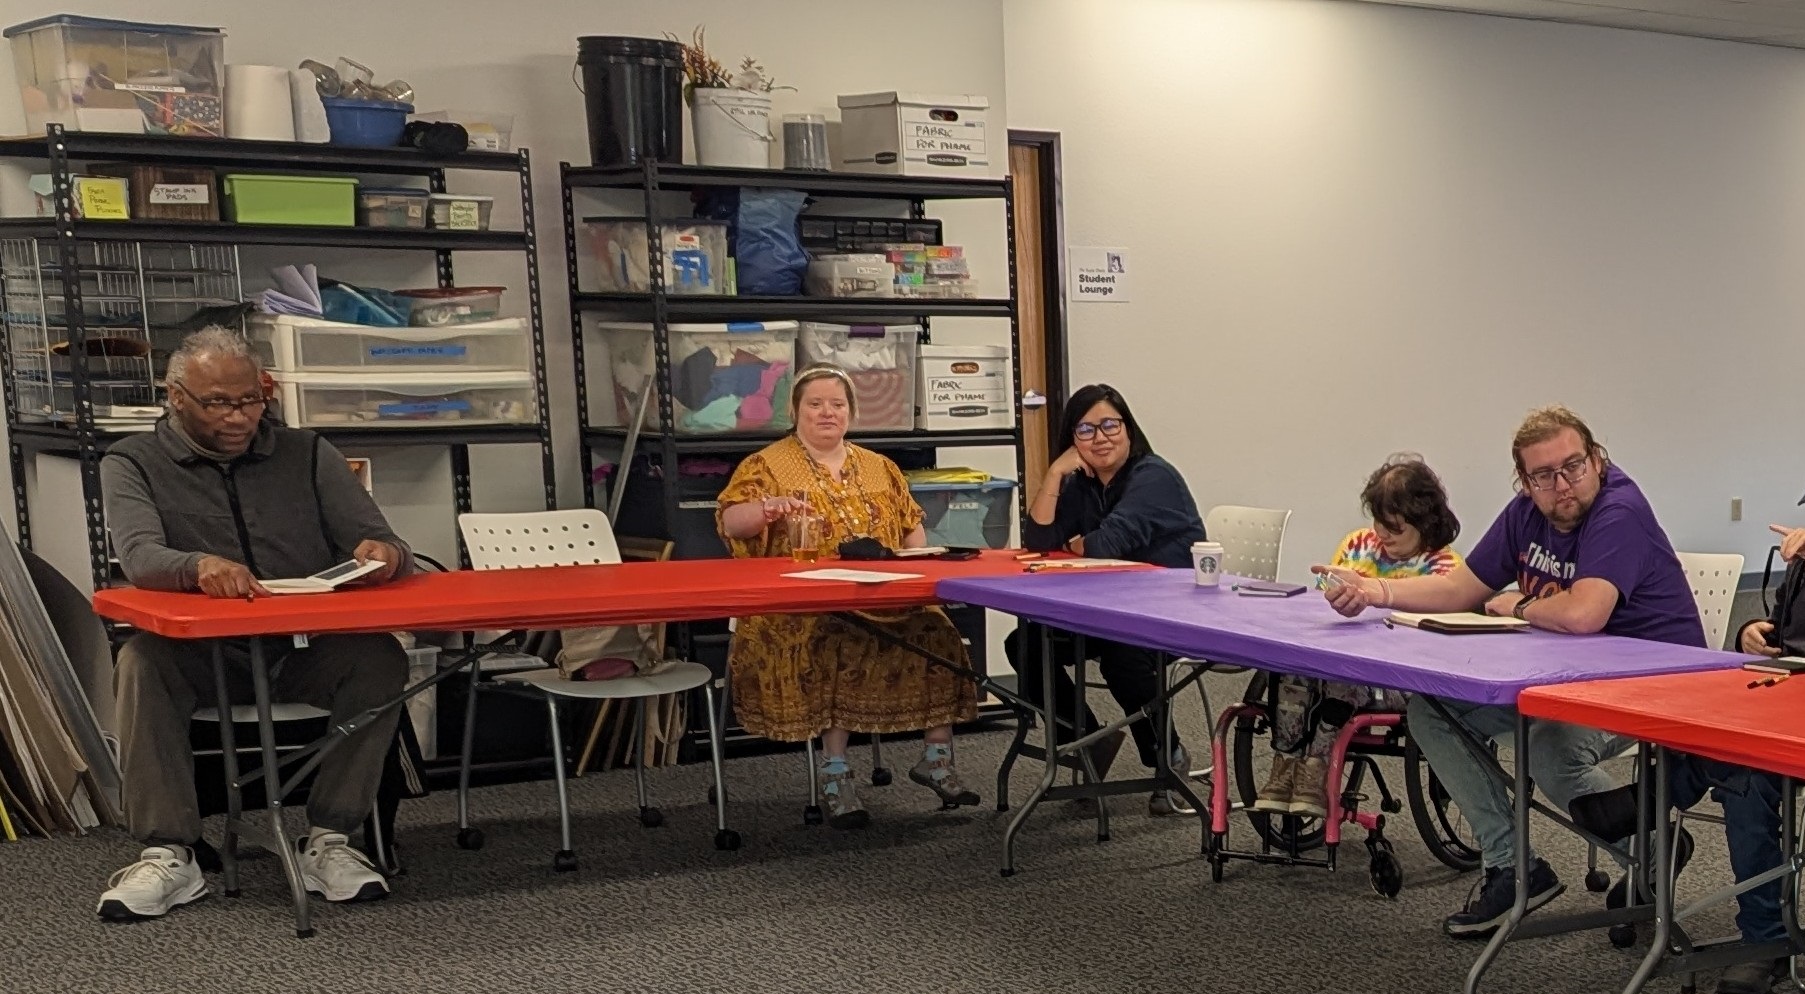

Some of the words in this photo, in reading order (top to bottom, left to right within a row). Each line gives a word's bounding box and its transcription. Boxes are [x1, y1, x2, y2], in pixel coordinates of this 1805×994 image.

[916, 139, 936, 149] FOR
[1078, 274, 1116, 283] Student
[1079, 284, 1114, 296] Lounge
[933, 393, 951, 402] FOR
